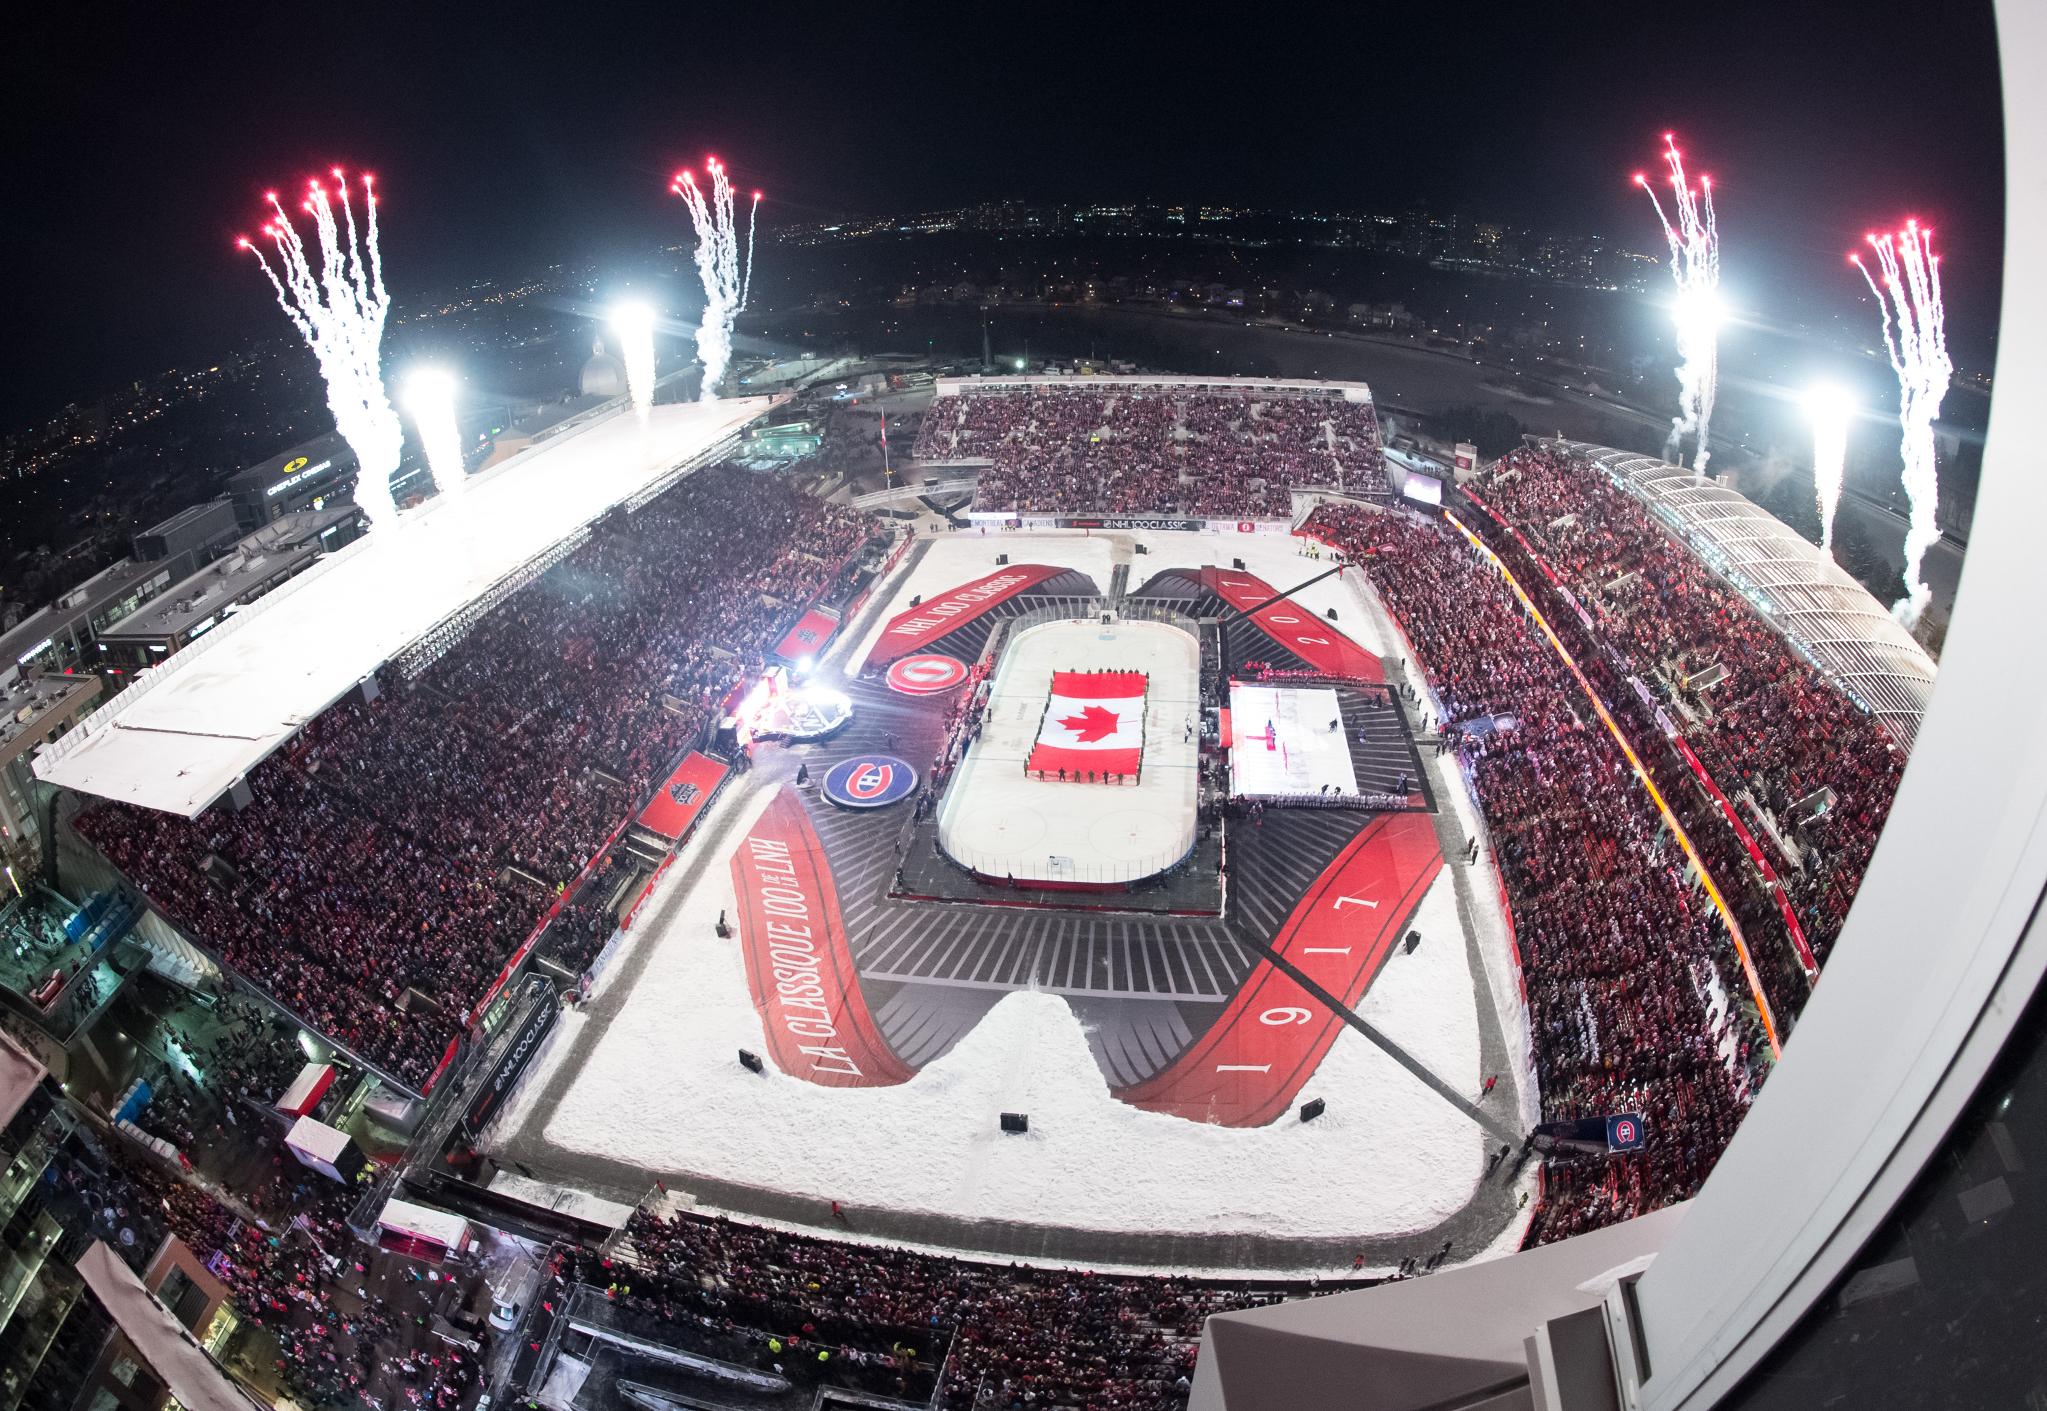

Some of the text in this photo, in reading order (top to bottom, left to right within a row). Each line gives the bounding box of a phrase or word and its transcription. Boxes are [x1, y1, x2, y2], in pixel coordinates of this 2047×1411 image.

[268, 475, 301, 496] CINEPLEX
[889, 575, 1028, 636] NHL 100 CLASSIC
[748, 836, 796, 876] LNH
[760, 887, 809, 921] 100
[766, 921, 838, 1038] CLASSIQUE
[797, 1043, 864, 1078] LA
